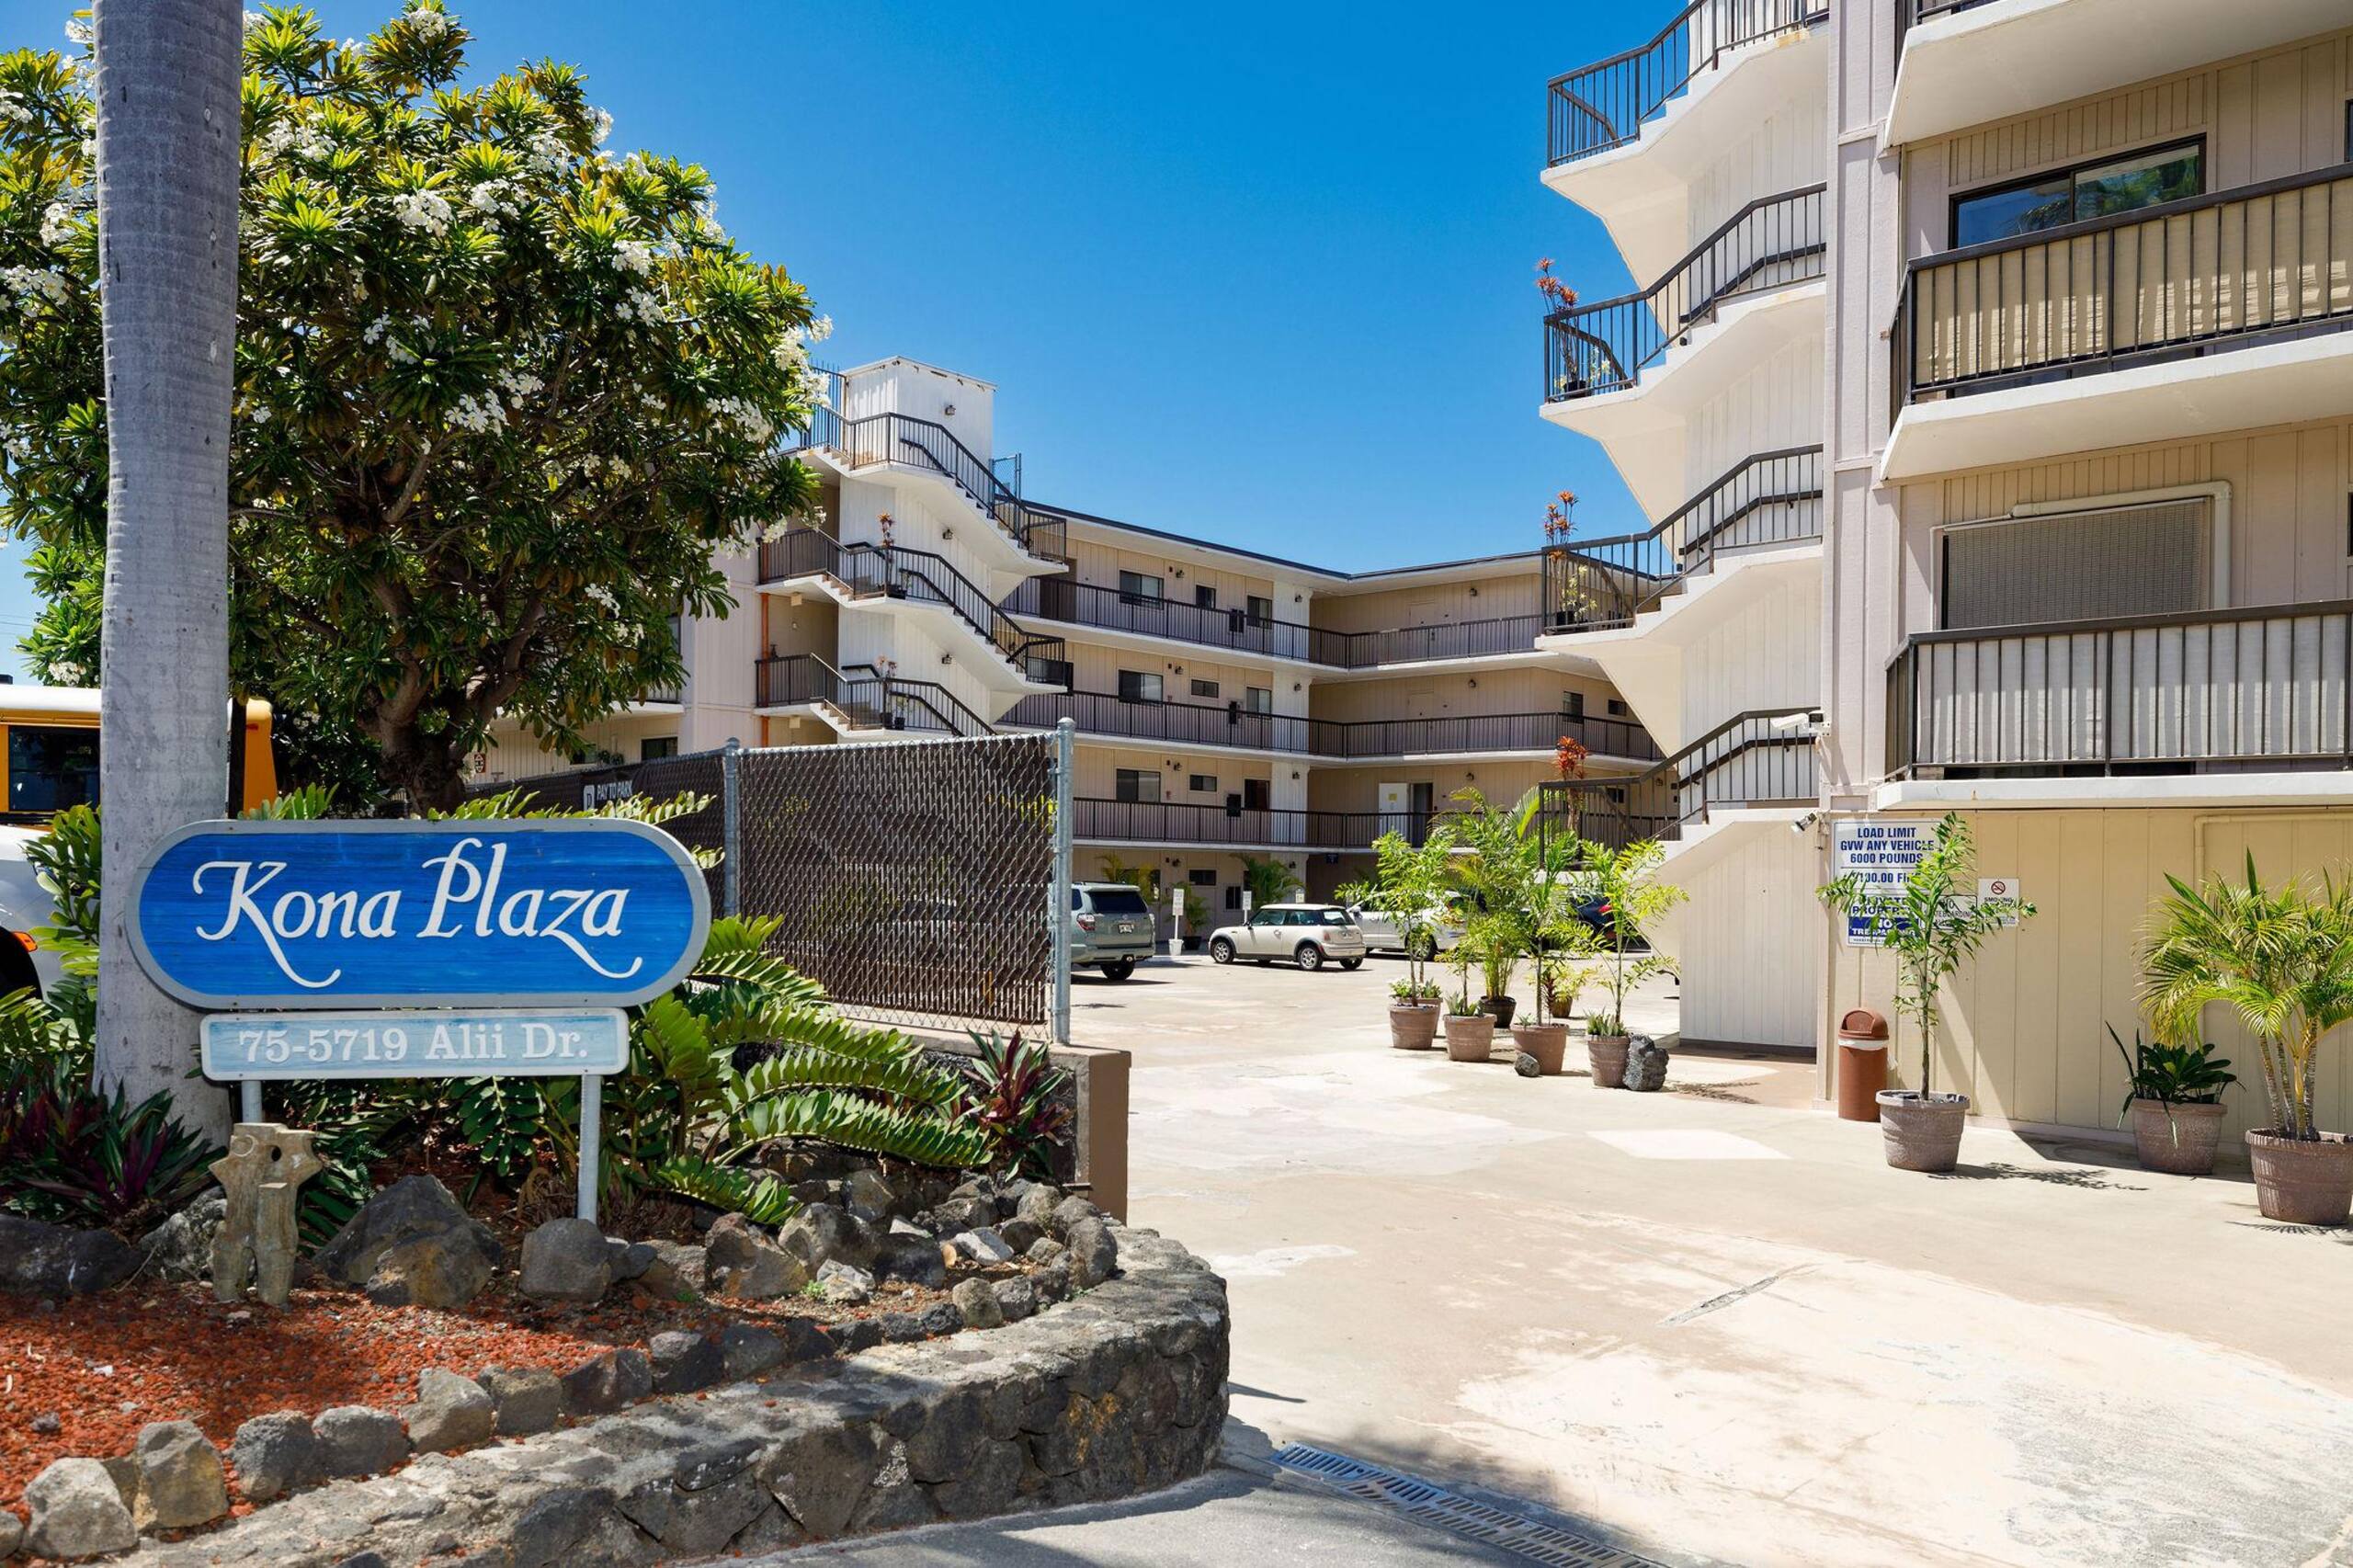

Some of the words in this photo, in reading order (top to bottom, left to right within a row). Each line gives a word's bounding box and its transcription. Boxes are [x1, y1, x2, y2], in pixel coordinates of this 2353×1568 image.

[597, 784, 608, 801] PAY
[608, 782, 617, 799] TO
[618, 779, 632, 798] PARK
[1857, 827, 1884, 838] LOAD
[1887, 827, 1916, 838] LIMIT
[1840, 840, 1864, 851] GVW
[1866, 840, 1888, 851] ANY
[1890, 840, 1935, 851] VEHICLE
[1850, 853, 1876, 864] 6000
[1879, 853, 1923, 864] POUNDS
[191, 860, 403, 989] Kona
[416, 837, 643, 979] Plaza
[238, 1027, 410, 1064] 75-5719
[424, 1023, 506, 1062] Alii
[520, 1022, 588, 1061] Dr.
